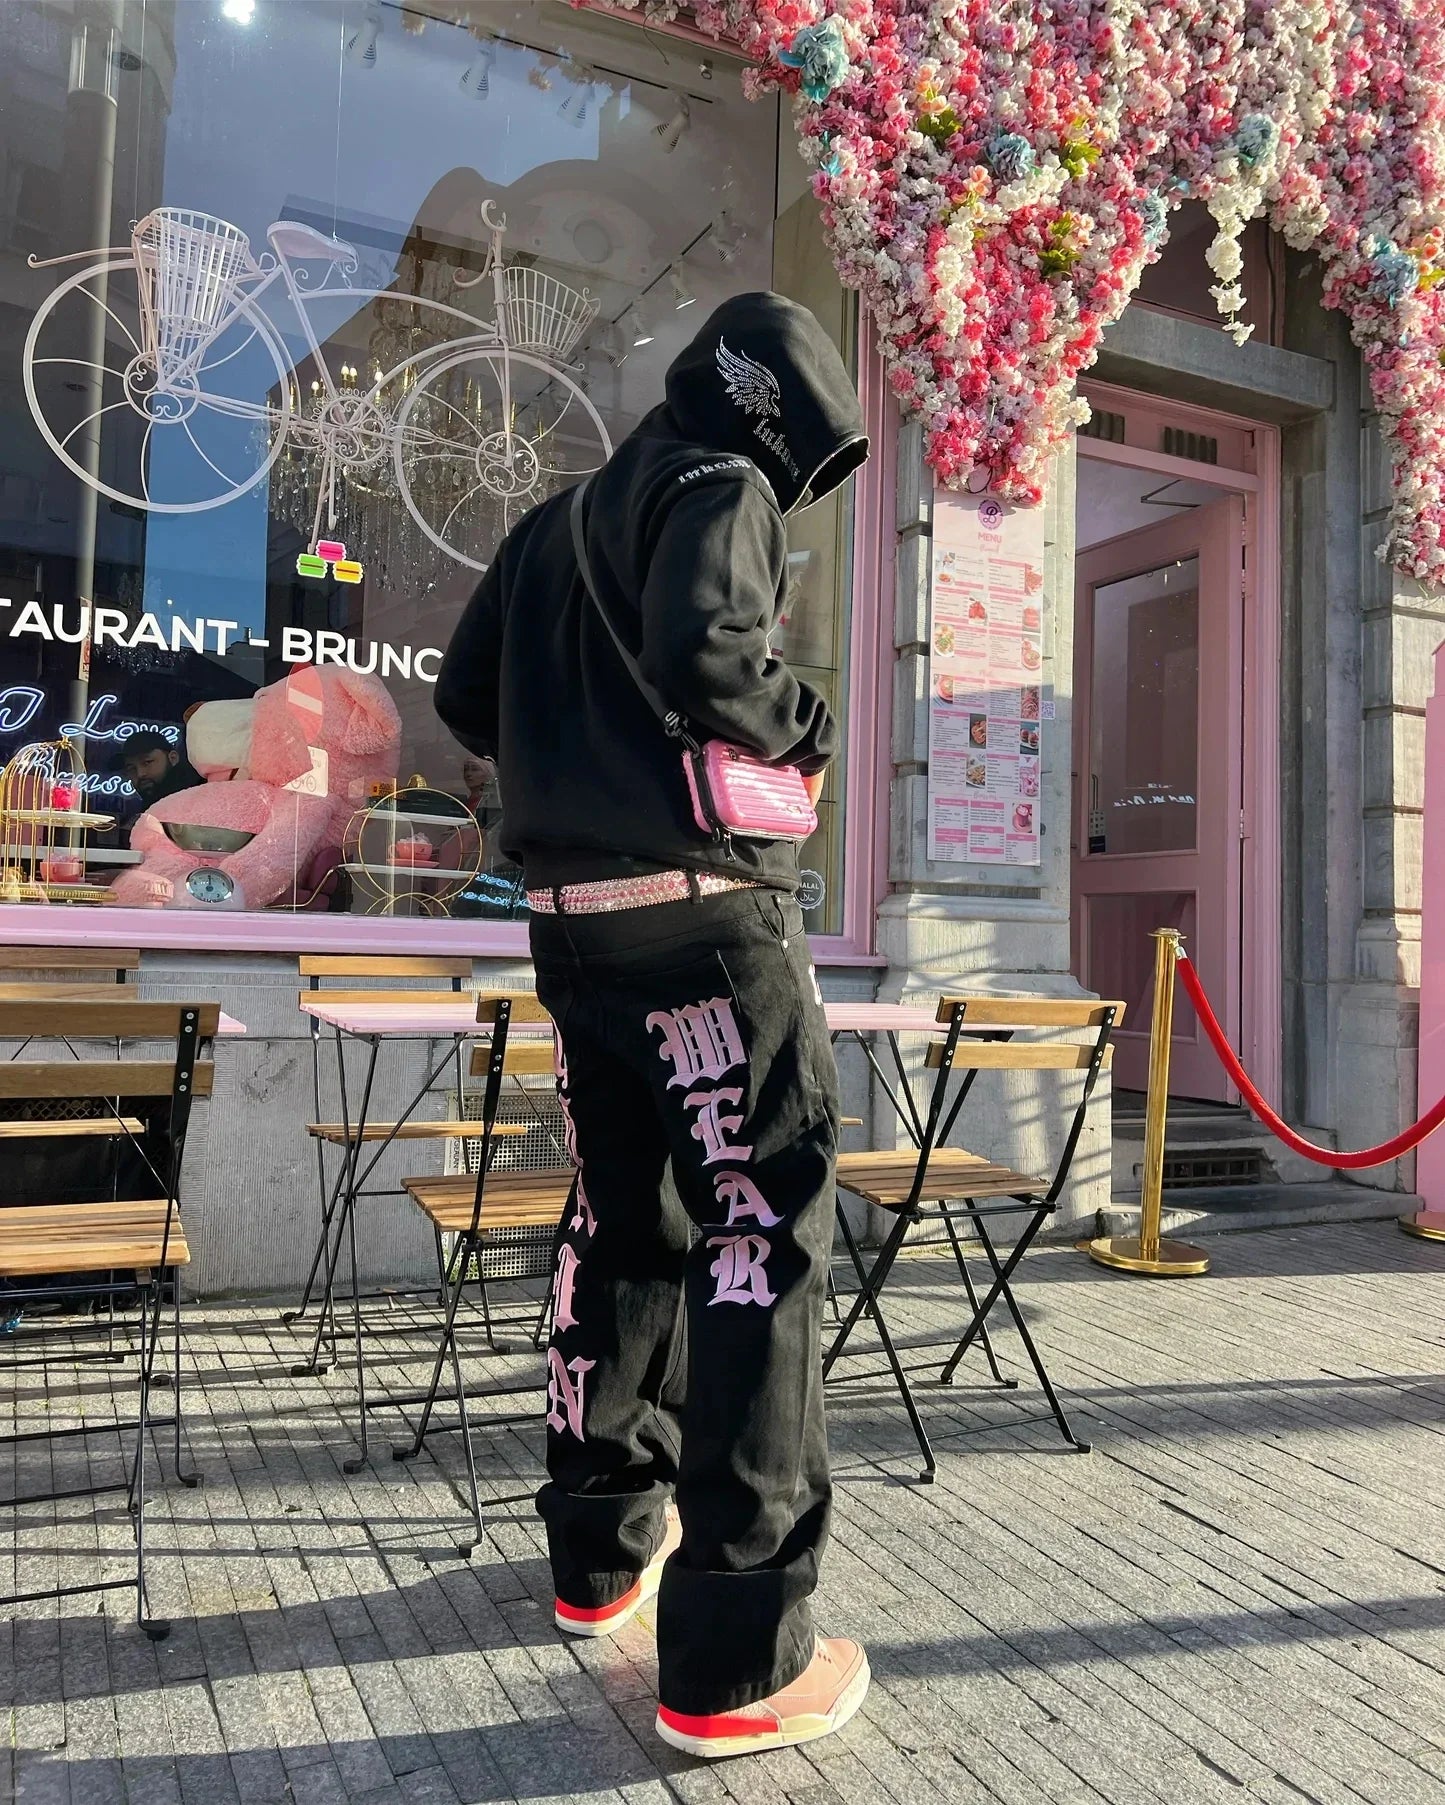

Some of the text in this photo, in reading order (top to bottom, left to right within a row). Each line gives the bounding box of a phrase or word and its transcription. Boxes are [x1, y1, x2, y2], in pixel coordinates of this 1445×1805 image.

[978, 532, 1002, 543] MENU
[282, 626, 444, 683] BRUNC
[646, 996, 786, 1308] WEAR
